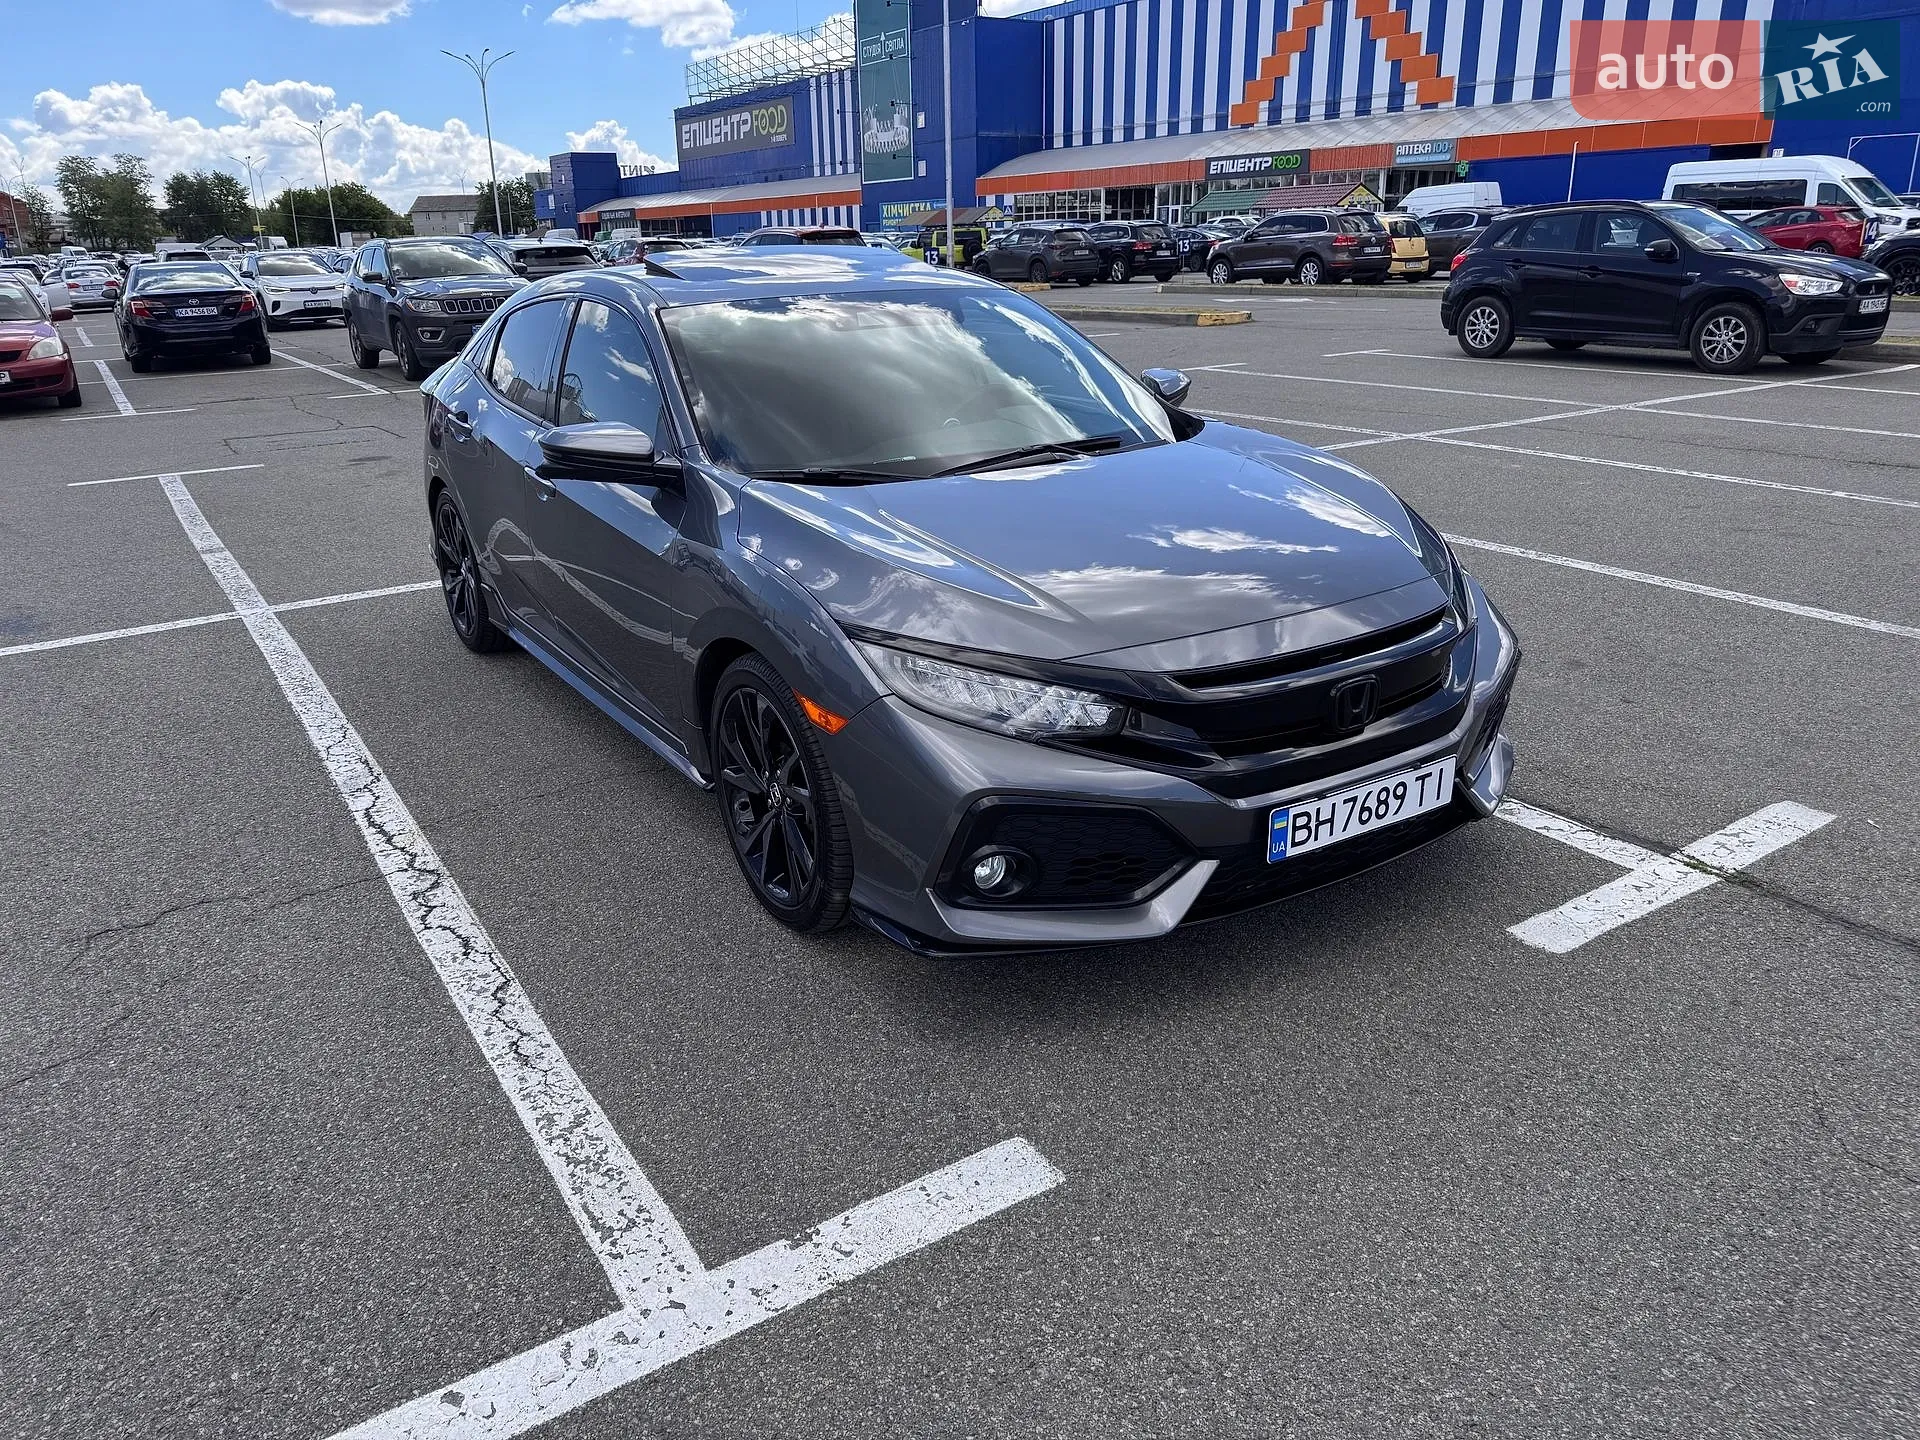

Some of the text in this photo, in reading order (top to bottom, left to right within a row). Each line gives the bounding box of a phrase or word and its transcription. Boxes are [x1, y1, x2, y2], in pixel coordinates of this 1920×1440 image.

[885, 37, 904, 52] СВІТЛА
[682, 105, 787, 149] ЕПІЦЕНТР FOOD
[1396, 143, 1431, 155] АПТЕКА
[1210, 154, 1301, 174] ЕПІЦЕНТР FOOD
[883, 202, 931, 218] ХІМЧИСТКА
[1865, 221, 1877, 240] 14
[1179, 240, 1190, 252] 13
[925, 250, 938, 265] 13
[1291, 767, 1444, 848] BH 7689 TI
[1272, 840, 1286, 853] UA
